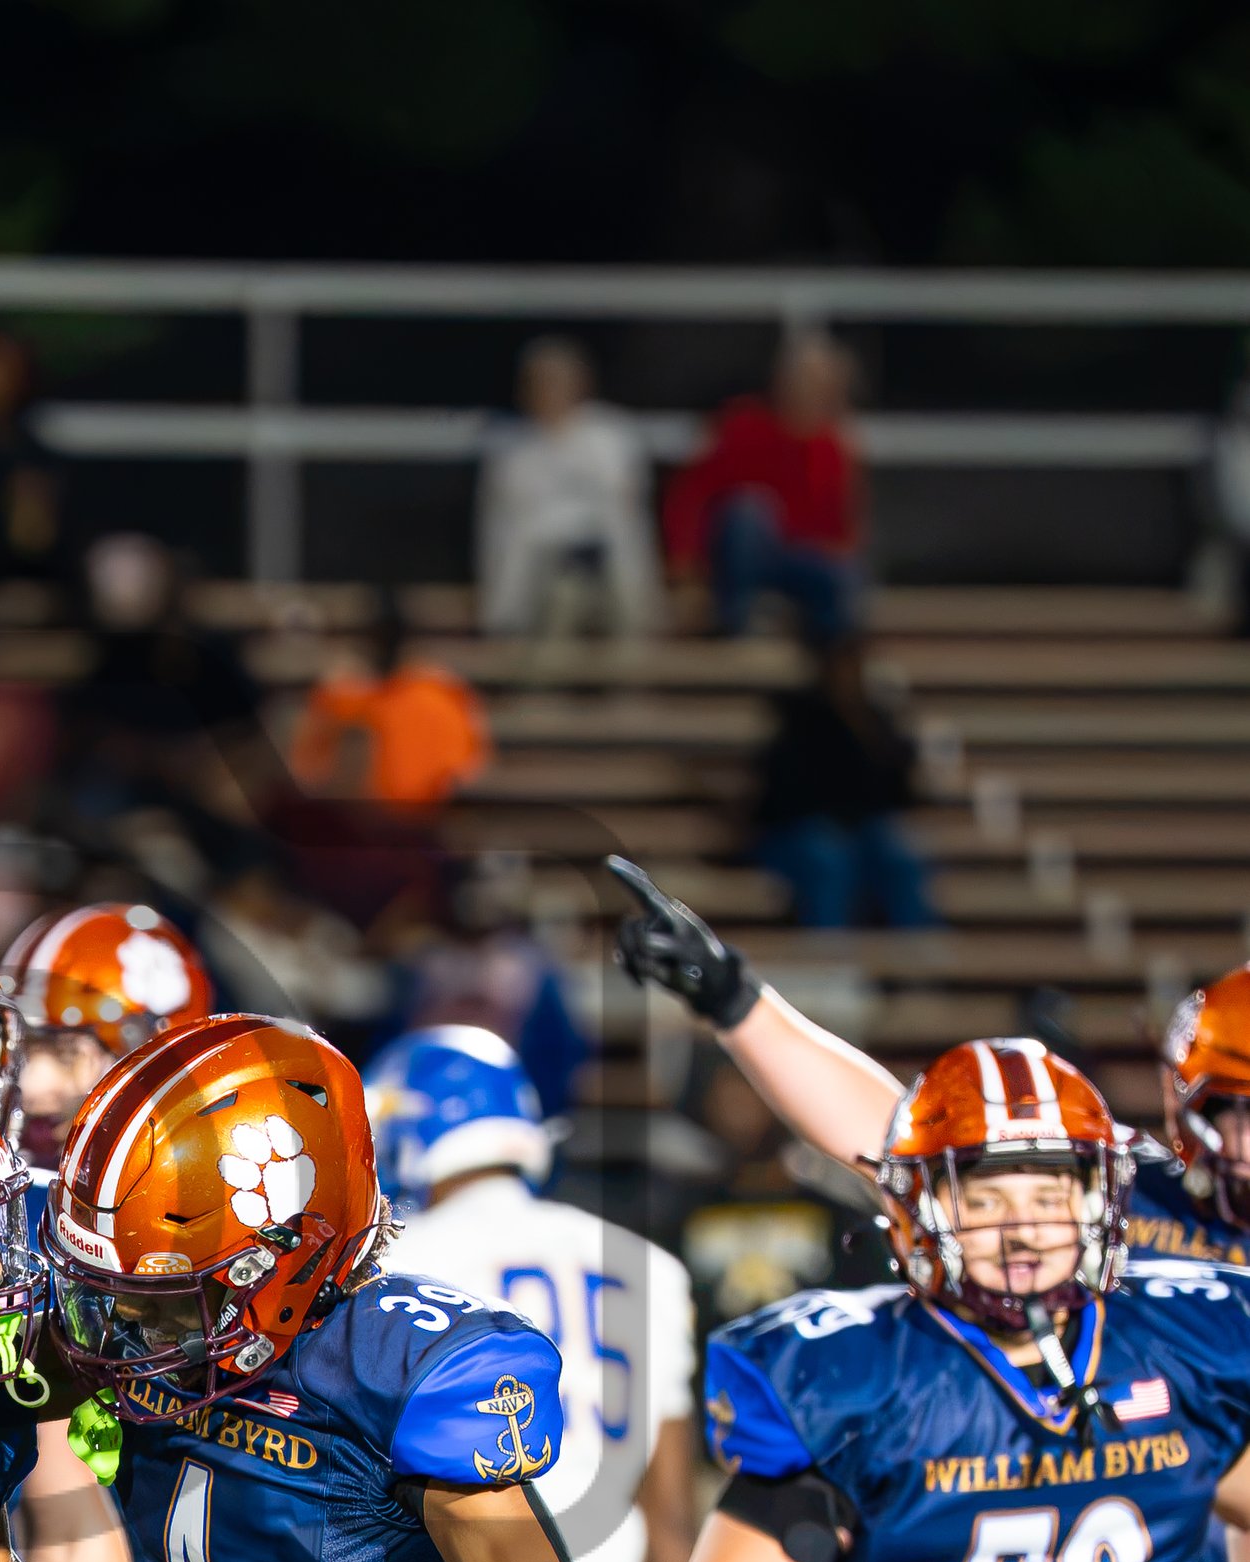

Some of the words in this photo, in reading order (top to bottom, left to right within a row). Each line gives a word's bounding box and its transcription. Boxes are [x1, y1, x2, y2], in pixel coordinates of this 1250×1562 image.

[59, 1219, 104, 1260] Riddell
[377, 1283, 486, 1333] 39
[488, 1393, 528, 1414] NAVY
[217, 1411, 318, 1470] BYRD
[925, 1445, 1096, 1495] WILLIAM
[1102, 1430, 1192, 1479] BYRD
